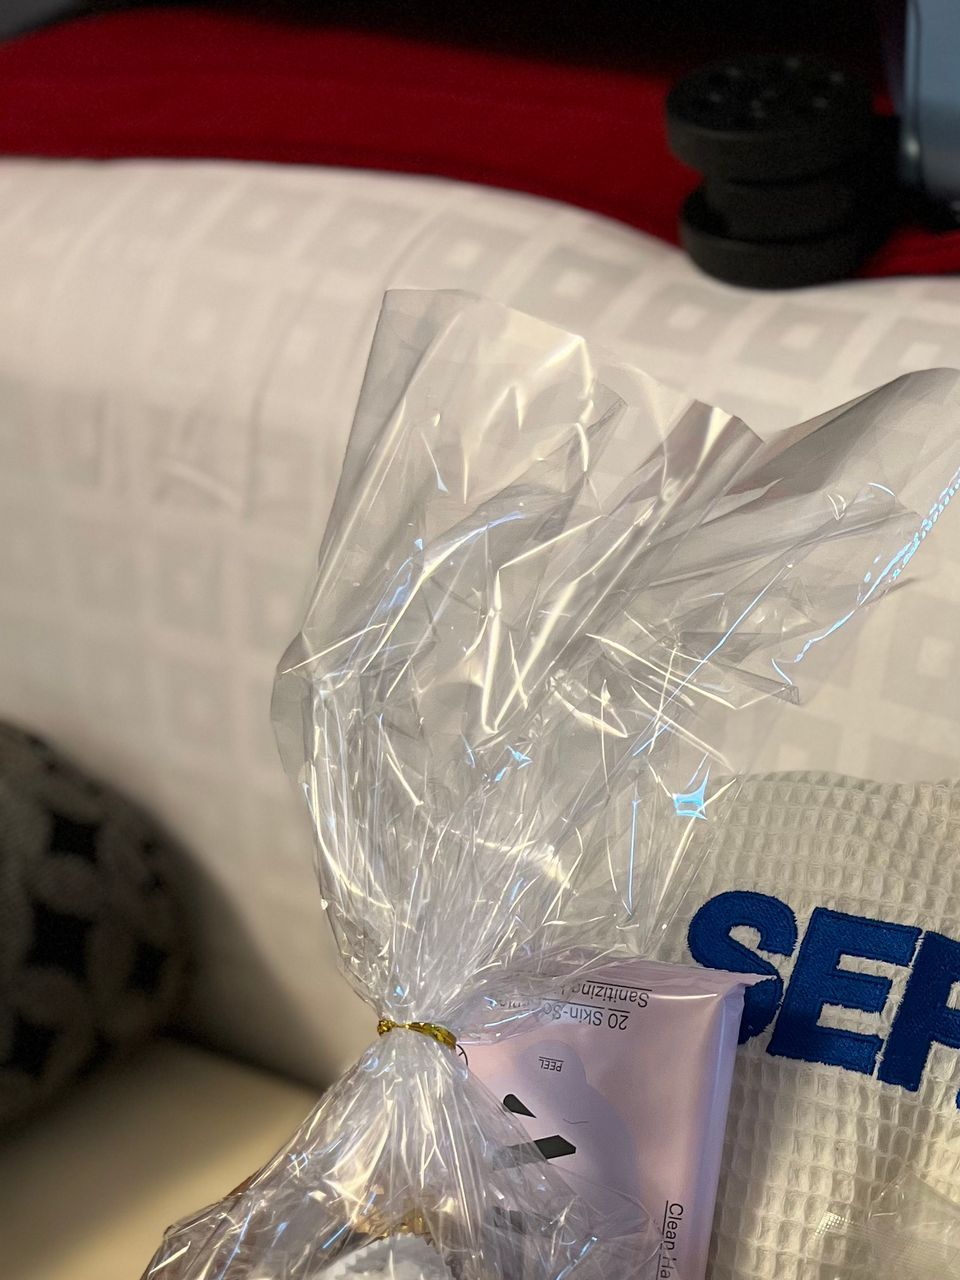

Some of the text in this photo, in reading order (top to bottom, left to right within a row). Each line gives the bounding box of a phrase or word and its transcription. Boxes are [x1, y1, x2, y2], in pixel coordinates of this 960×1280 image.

[608, 1011, 628, 1031] 20
[539, 1058, 564, 1073] PEEL
[663, 1202, 684, 1250] Clean
